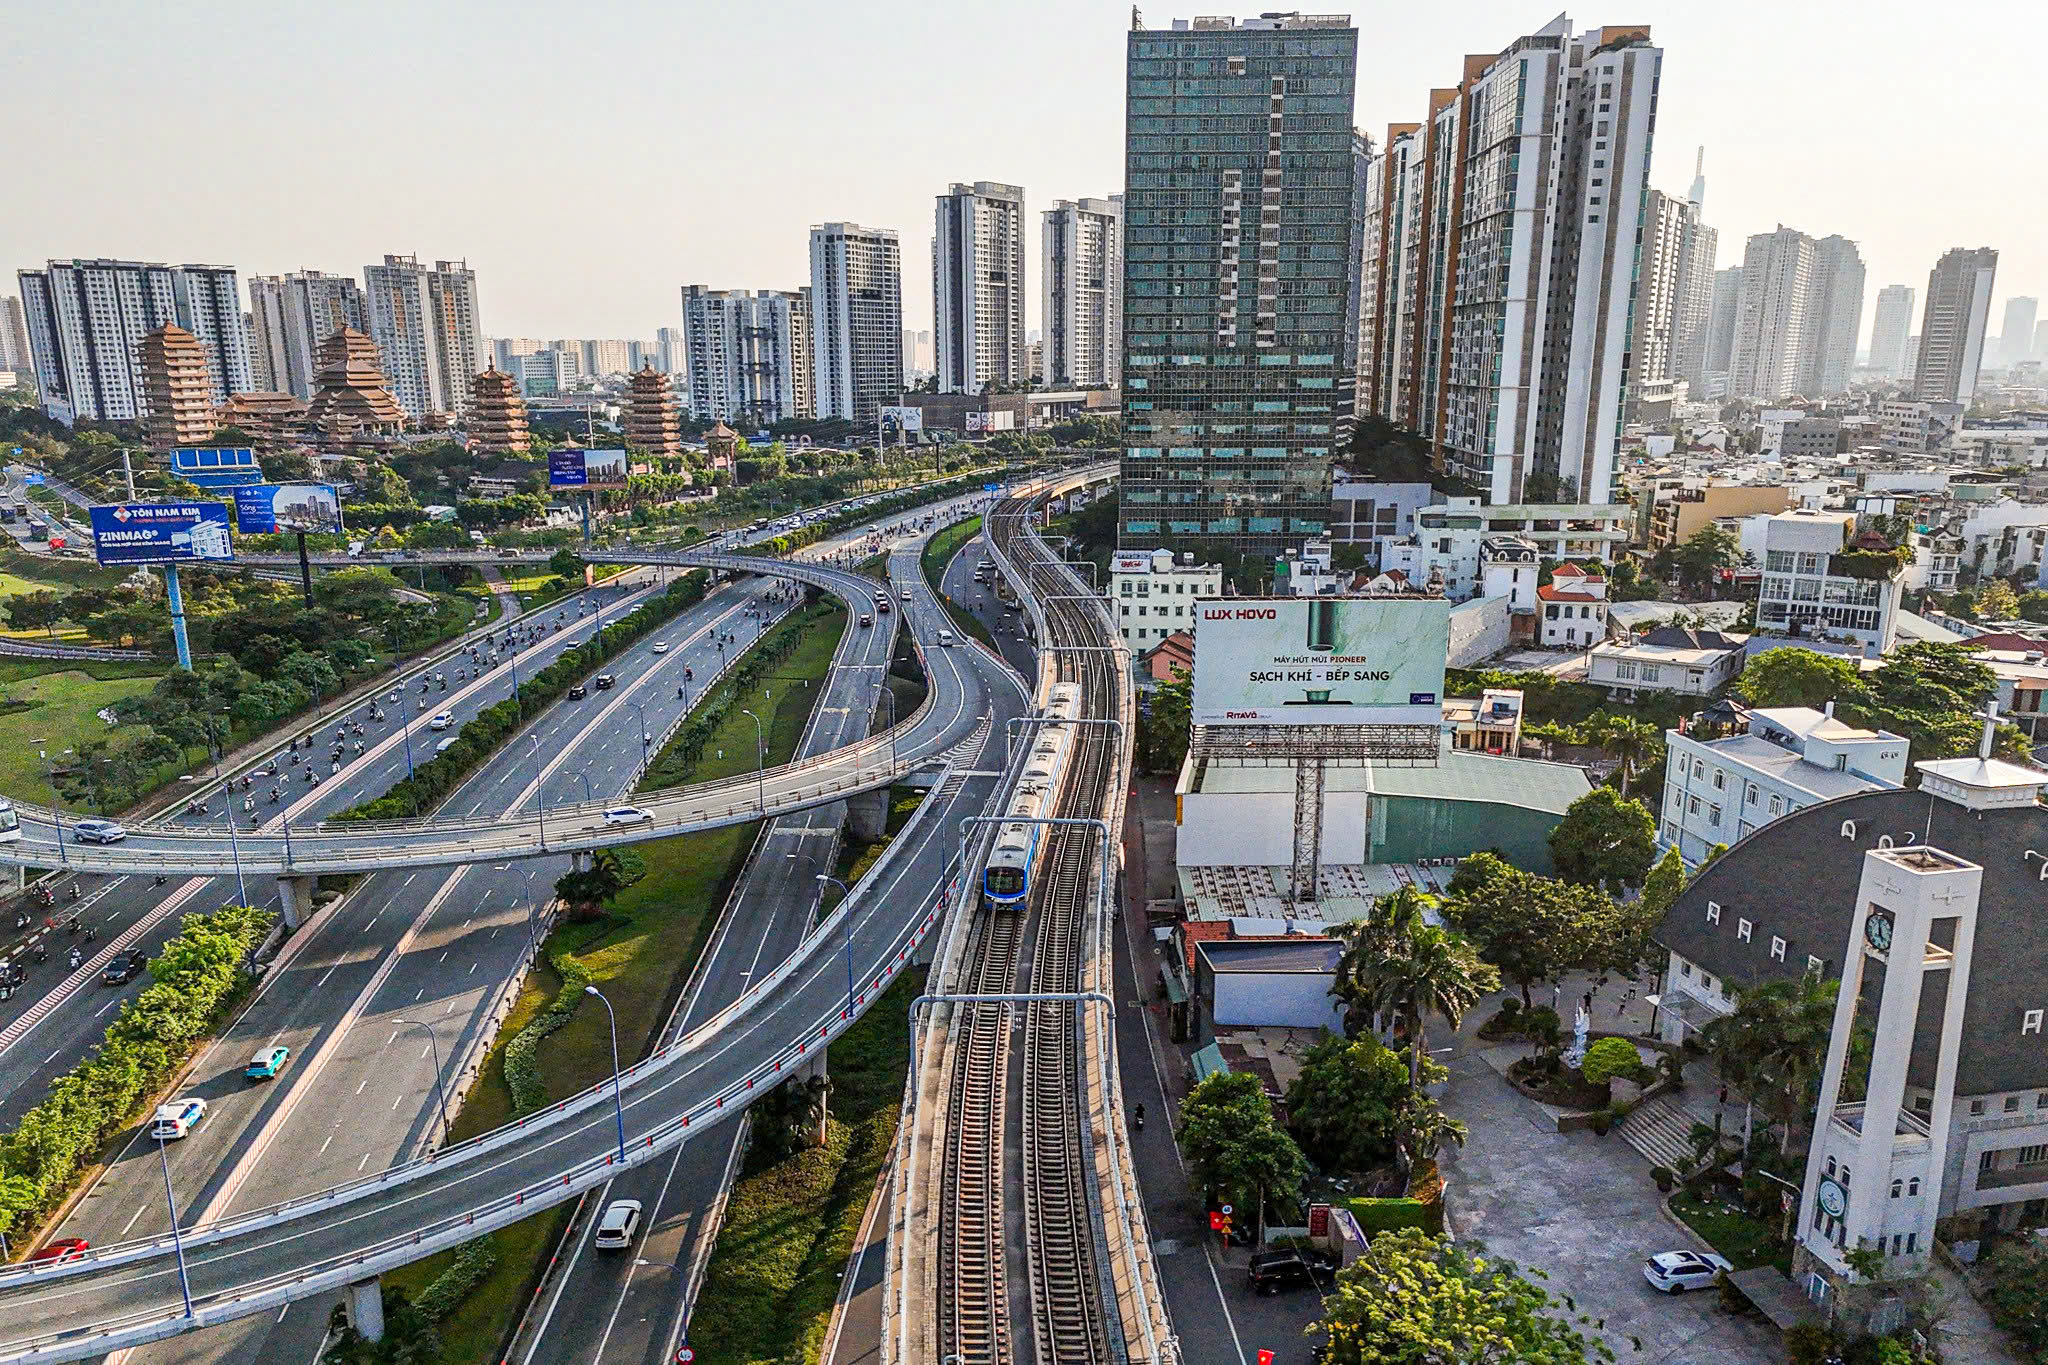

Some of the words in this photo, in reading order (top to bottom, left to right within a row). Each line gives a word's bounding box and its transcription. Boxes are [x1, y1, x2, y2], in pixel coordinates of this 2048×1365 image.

[131, 508, 153, 518] TÔN
[155, 508, 179, 516] NAM
[182, 507, 200, 516] KIM
[1204, 609, 1232, 620] LUX
[1236, 609, 1276, 619] HOVO
[1274, 655, 1291, 663] MÁY
[1292, 655, 1310, 663] HÚT
[1250, 671, 1283, 684] SẠCH
[1288, 669, 1312, 681] KHÍ
[1326, 667, 1350, 681] BẾP
[1354, 671, 1390, 681] SANG
